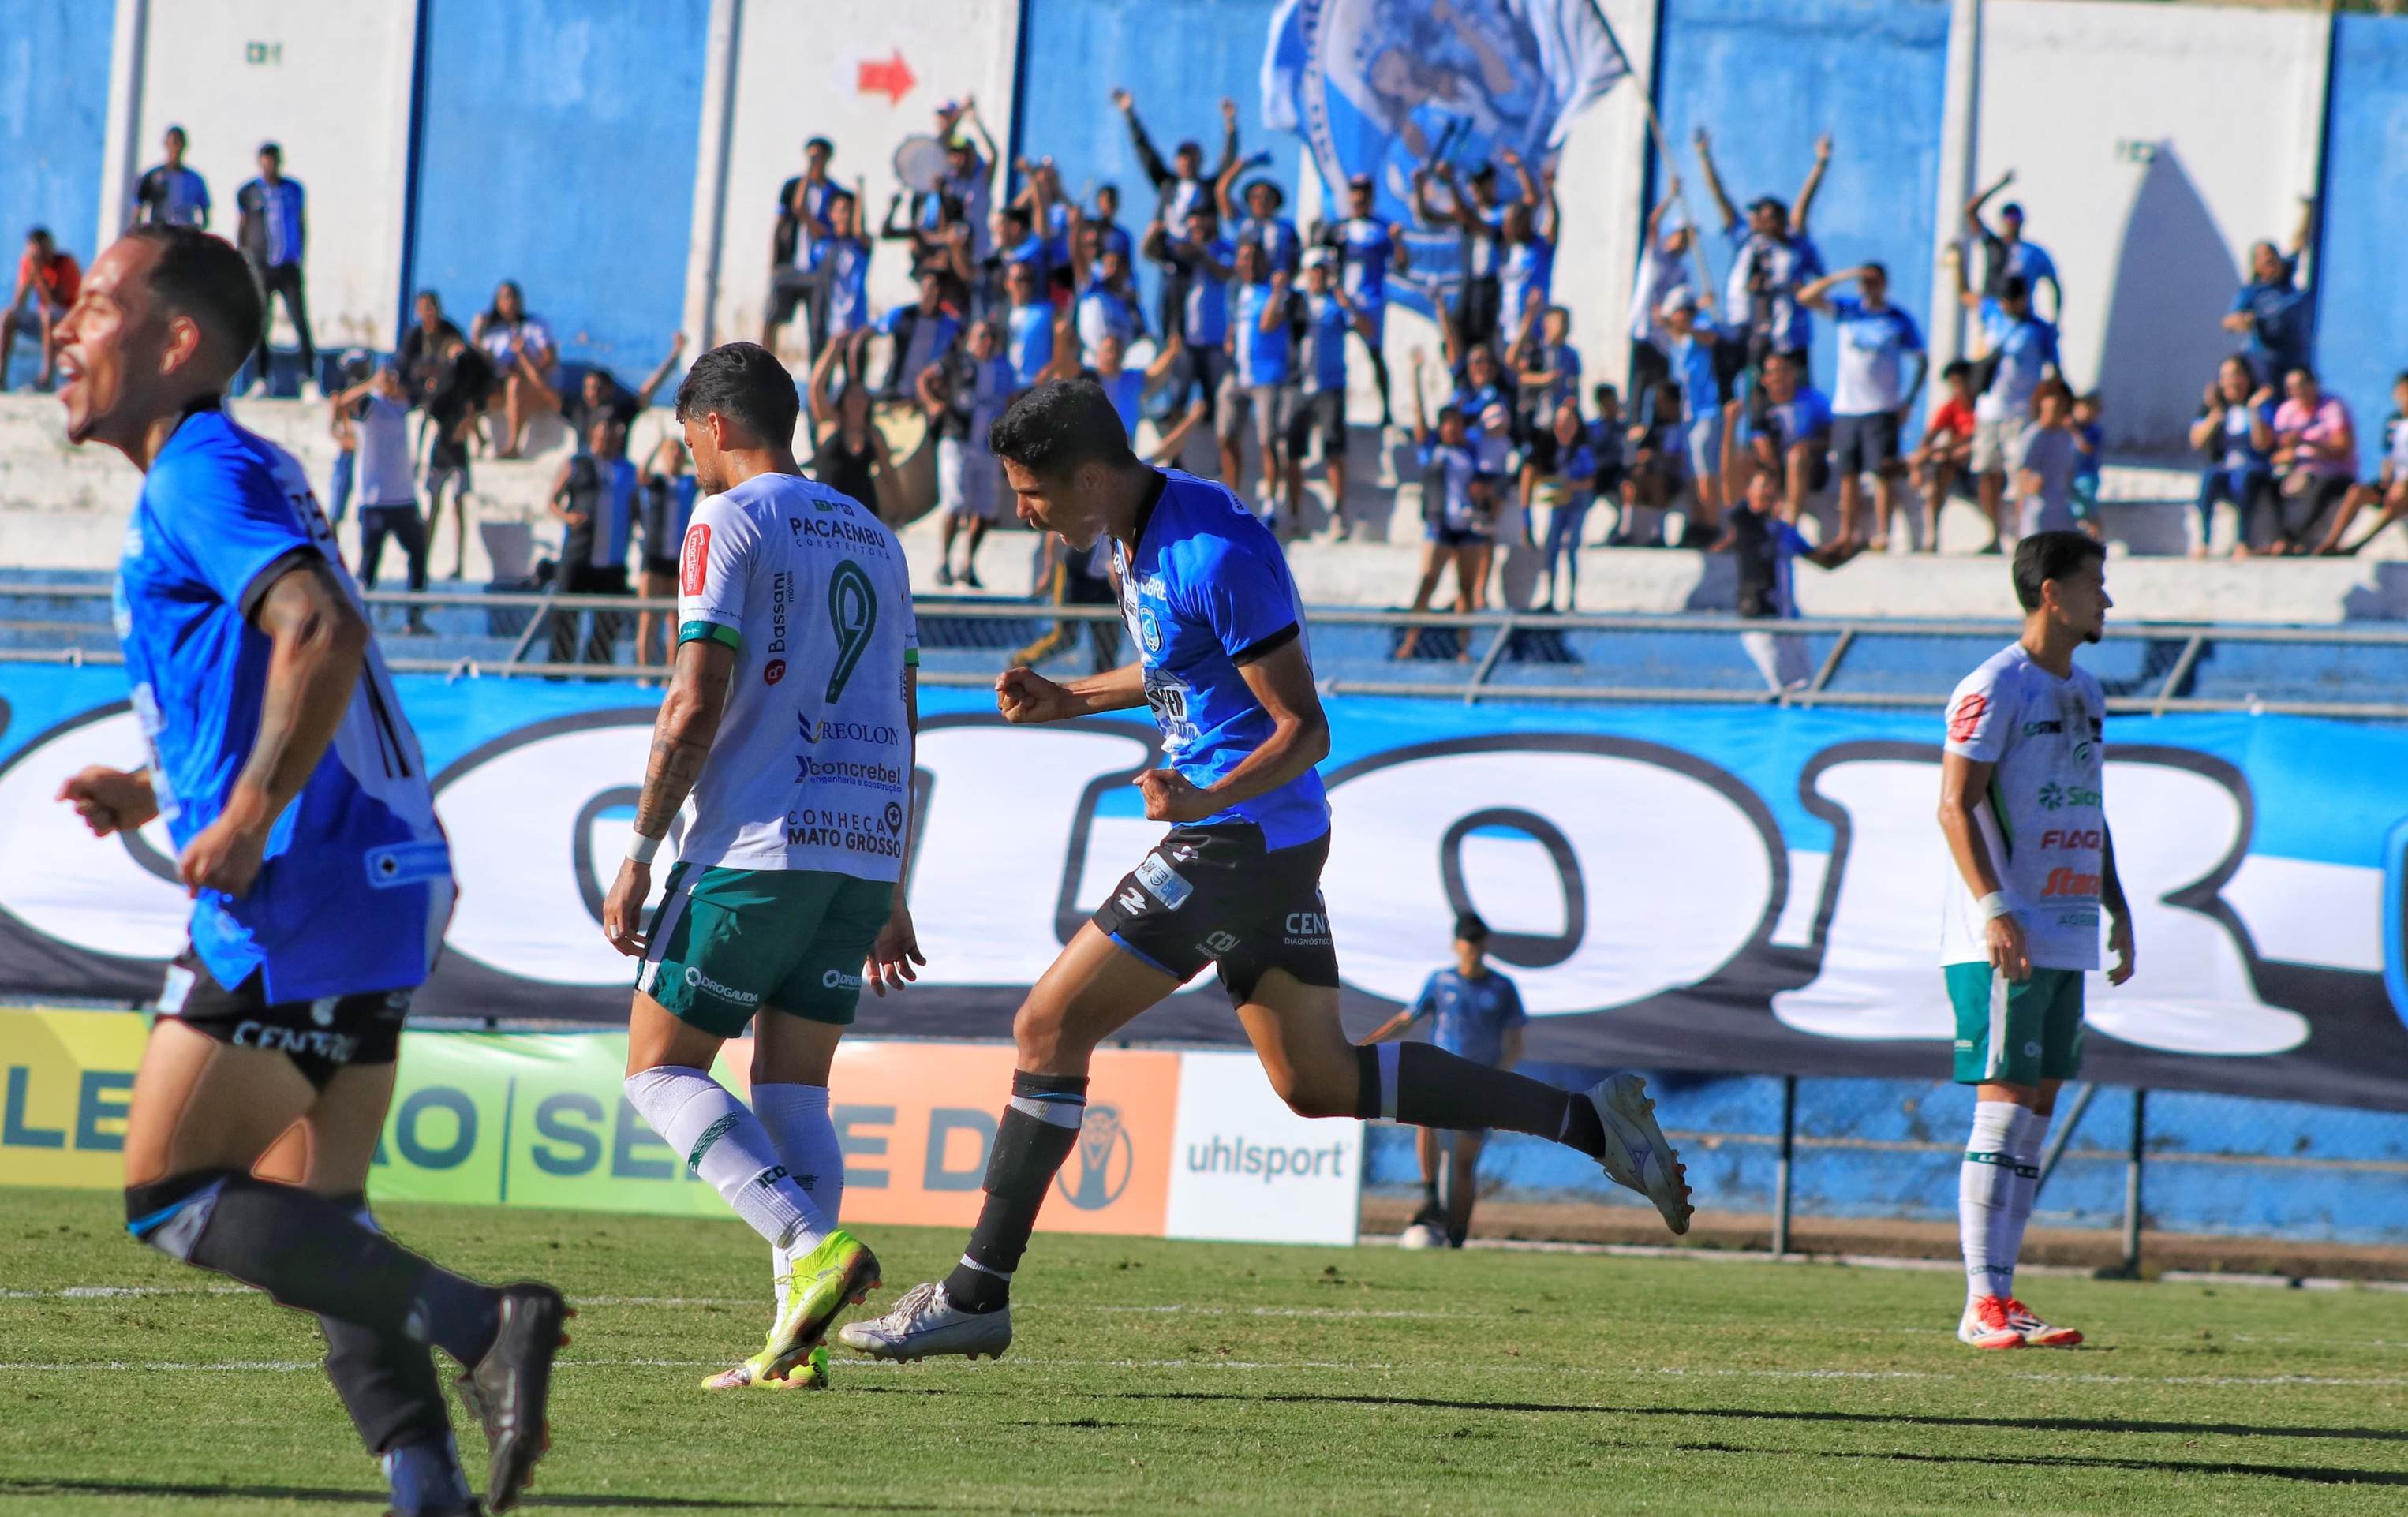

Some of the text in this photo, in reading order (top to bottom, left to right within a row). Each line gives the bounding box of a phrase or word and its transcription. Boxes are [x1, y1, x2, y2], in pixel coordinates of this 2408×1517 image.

[789, 517, 886, 549] PACAEMBU
[796, 538, 891, 561] CONSTRUTORA
[768, 572, 786, 653] Bassani
[825, 559, 877, 704] 9
[821, 721, 899, 745] REOLON
[810, 762, 901, 784] concrebel
[810, 775, 856, 786] engenharia
[787, 809, 886, 836] CONHEÇA
[787, 828, 901, 858] MATO GROSSO
[701, 975, 758, 1003] DROGAVIDA
[922, 1105, 1000, 1192] D
[1187, 1134, 1344, 1184] uhlsport
